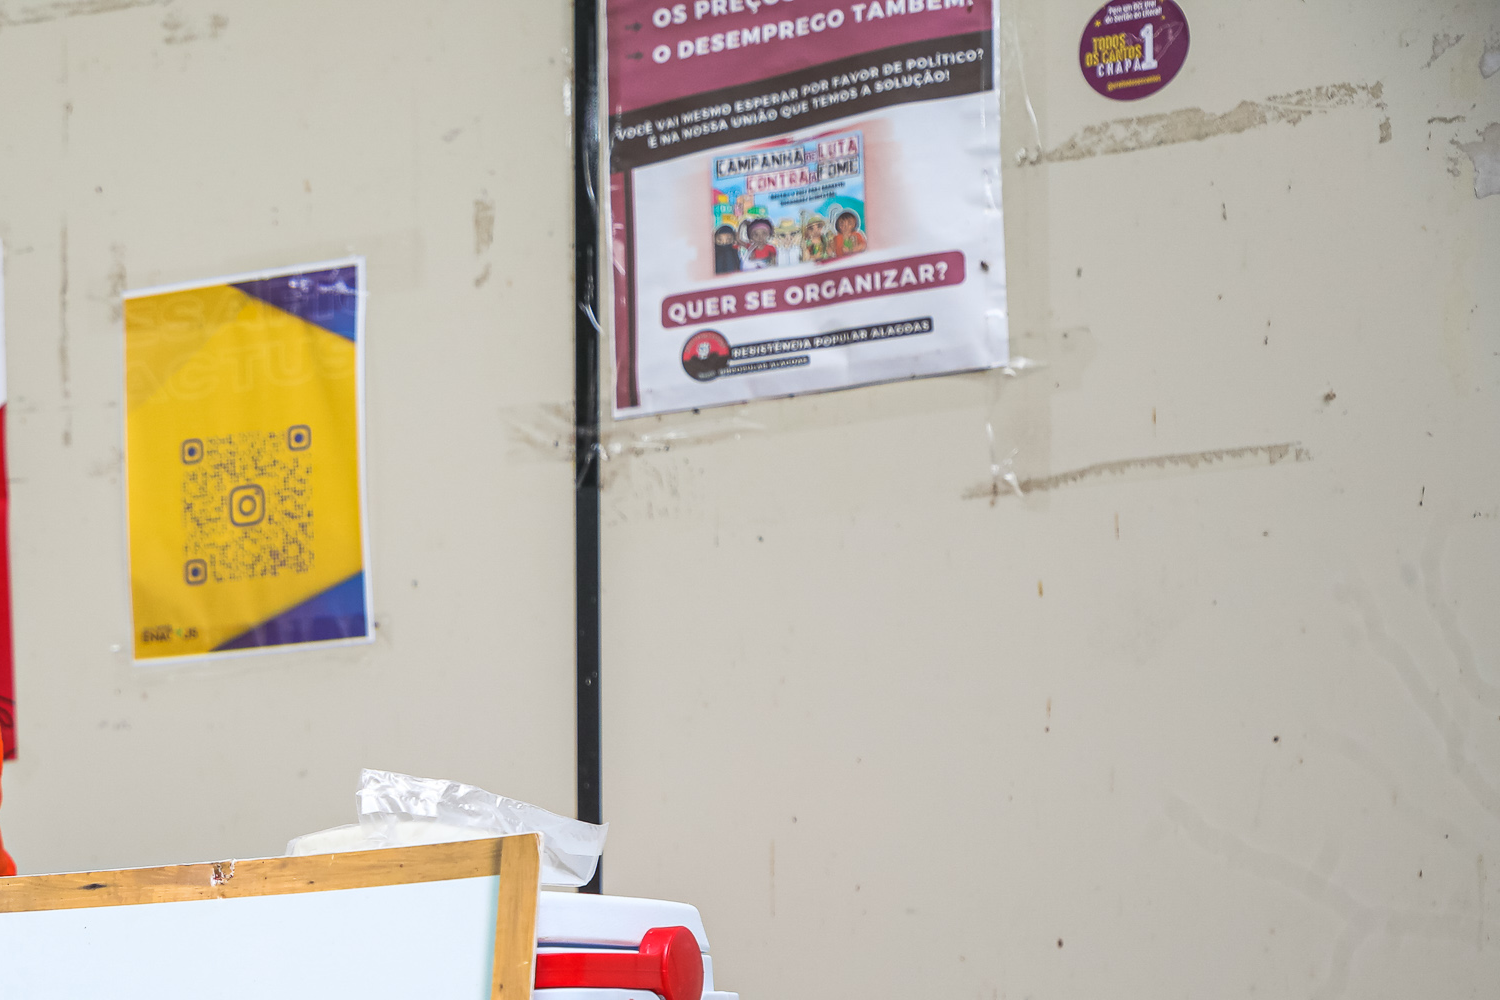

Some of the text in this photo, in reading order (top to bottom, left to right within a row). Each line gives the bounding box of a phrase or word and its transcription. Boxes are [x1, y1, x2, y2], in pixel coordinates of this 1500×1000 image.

[652, 0, 795, 28] OS PREÇ
[652, 45, 671, 64] O
[677, 8, 845, 60] DESEMPREGO
[1085, 43, 1142, 68] OS CANTOS
[1092, 32, 1127, 53] TODOS
[1096, 22, 1158, 79] CHAPA 1
[617, 48, 985, 142] VOCÊ VAI MESMO ESPERAR POR FAVOR DE POLÍTICO?
[660, 130, 681, 147] NA
[681, 118, 729, 141] NOSSA
[730, 108, 778, 130] UNIÃO
[779, 100, 809, 120] QUE
[812, 87, 858, 110] TEMOS
[860, 83, 872, 97] A
[874, 69, 951, 93] SOLUÇÃO!
[717, 147, 805, 178] CAMPANHA
[818, 135, 859, 159] LUTA
[747, 167, 809, 193] CONTRA
[818, 159, 860, 181] FOME
[668, 260, 950, 327] QUER SE ORGANIZAR?
